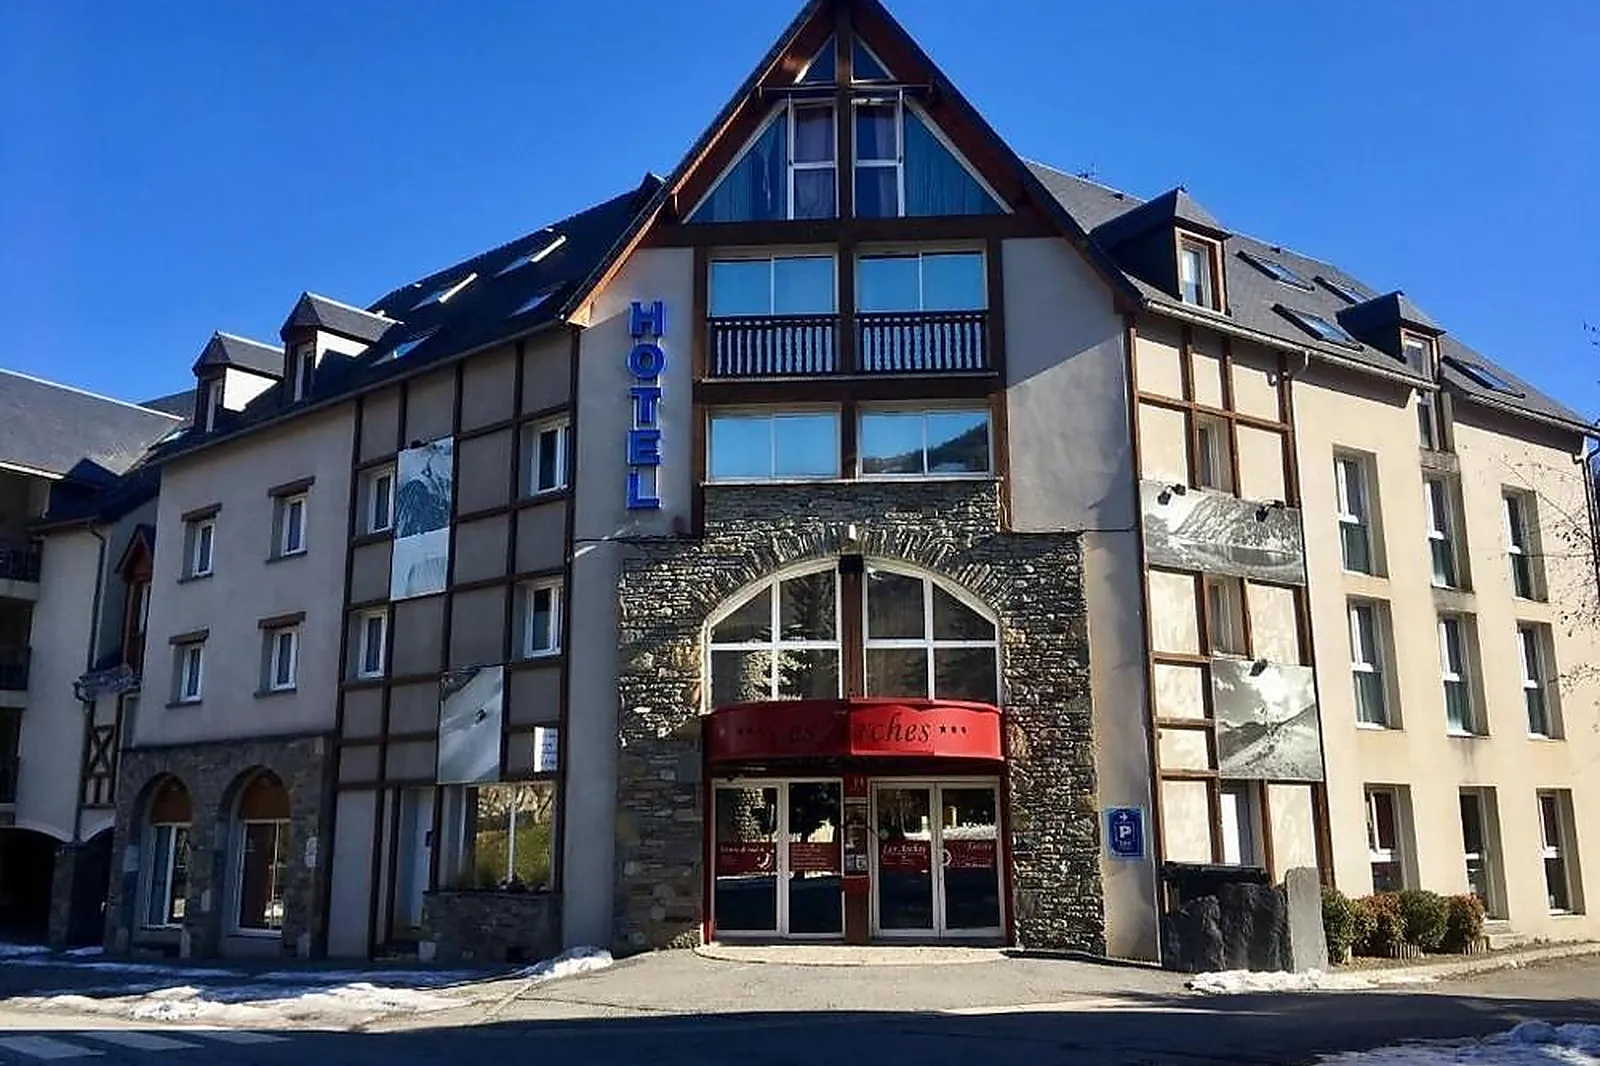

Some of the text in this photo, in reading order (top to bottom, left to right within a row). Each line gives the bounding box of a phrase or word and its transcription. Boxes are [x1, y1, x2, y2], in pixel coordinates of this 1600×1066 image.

[626, 299, 666, 510] HOTEL
[828, 711, 931, 741] rches
[1119, 825, 1132, 838] P
